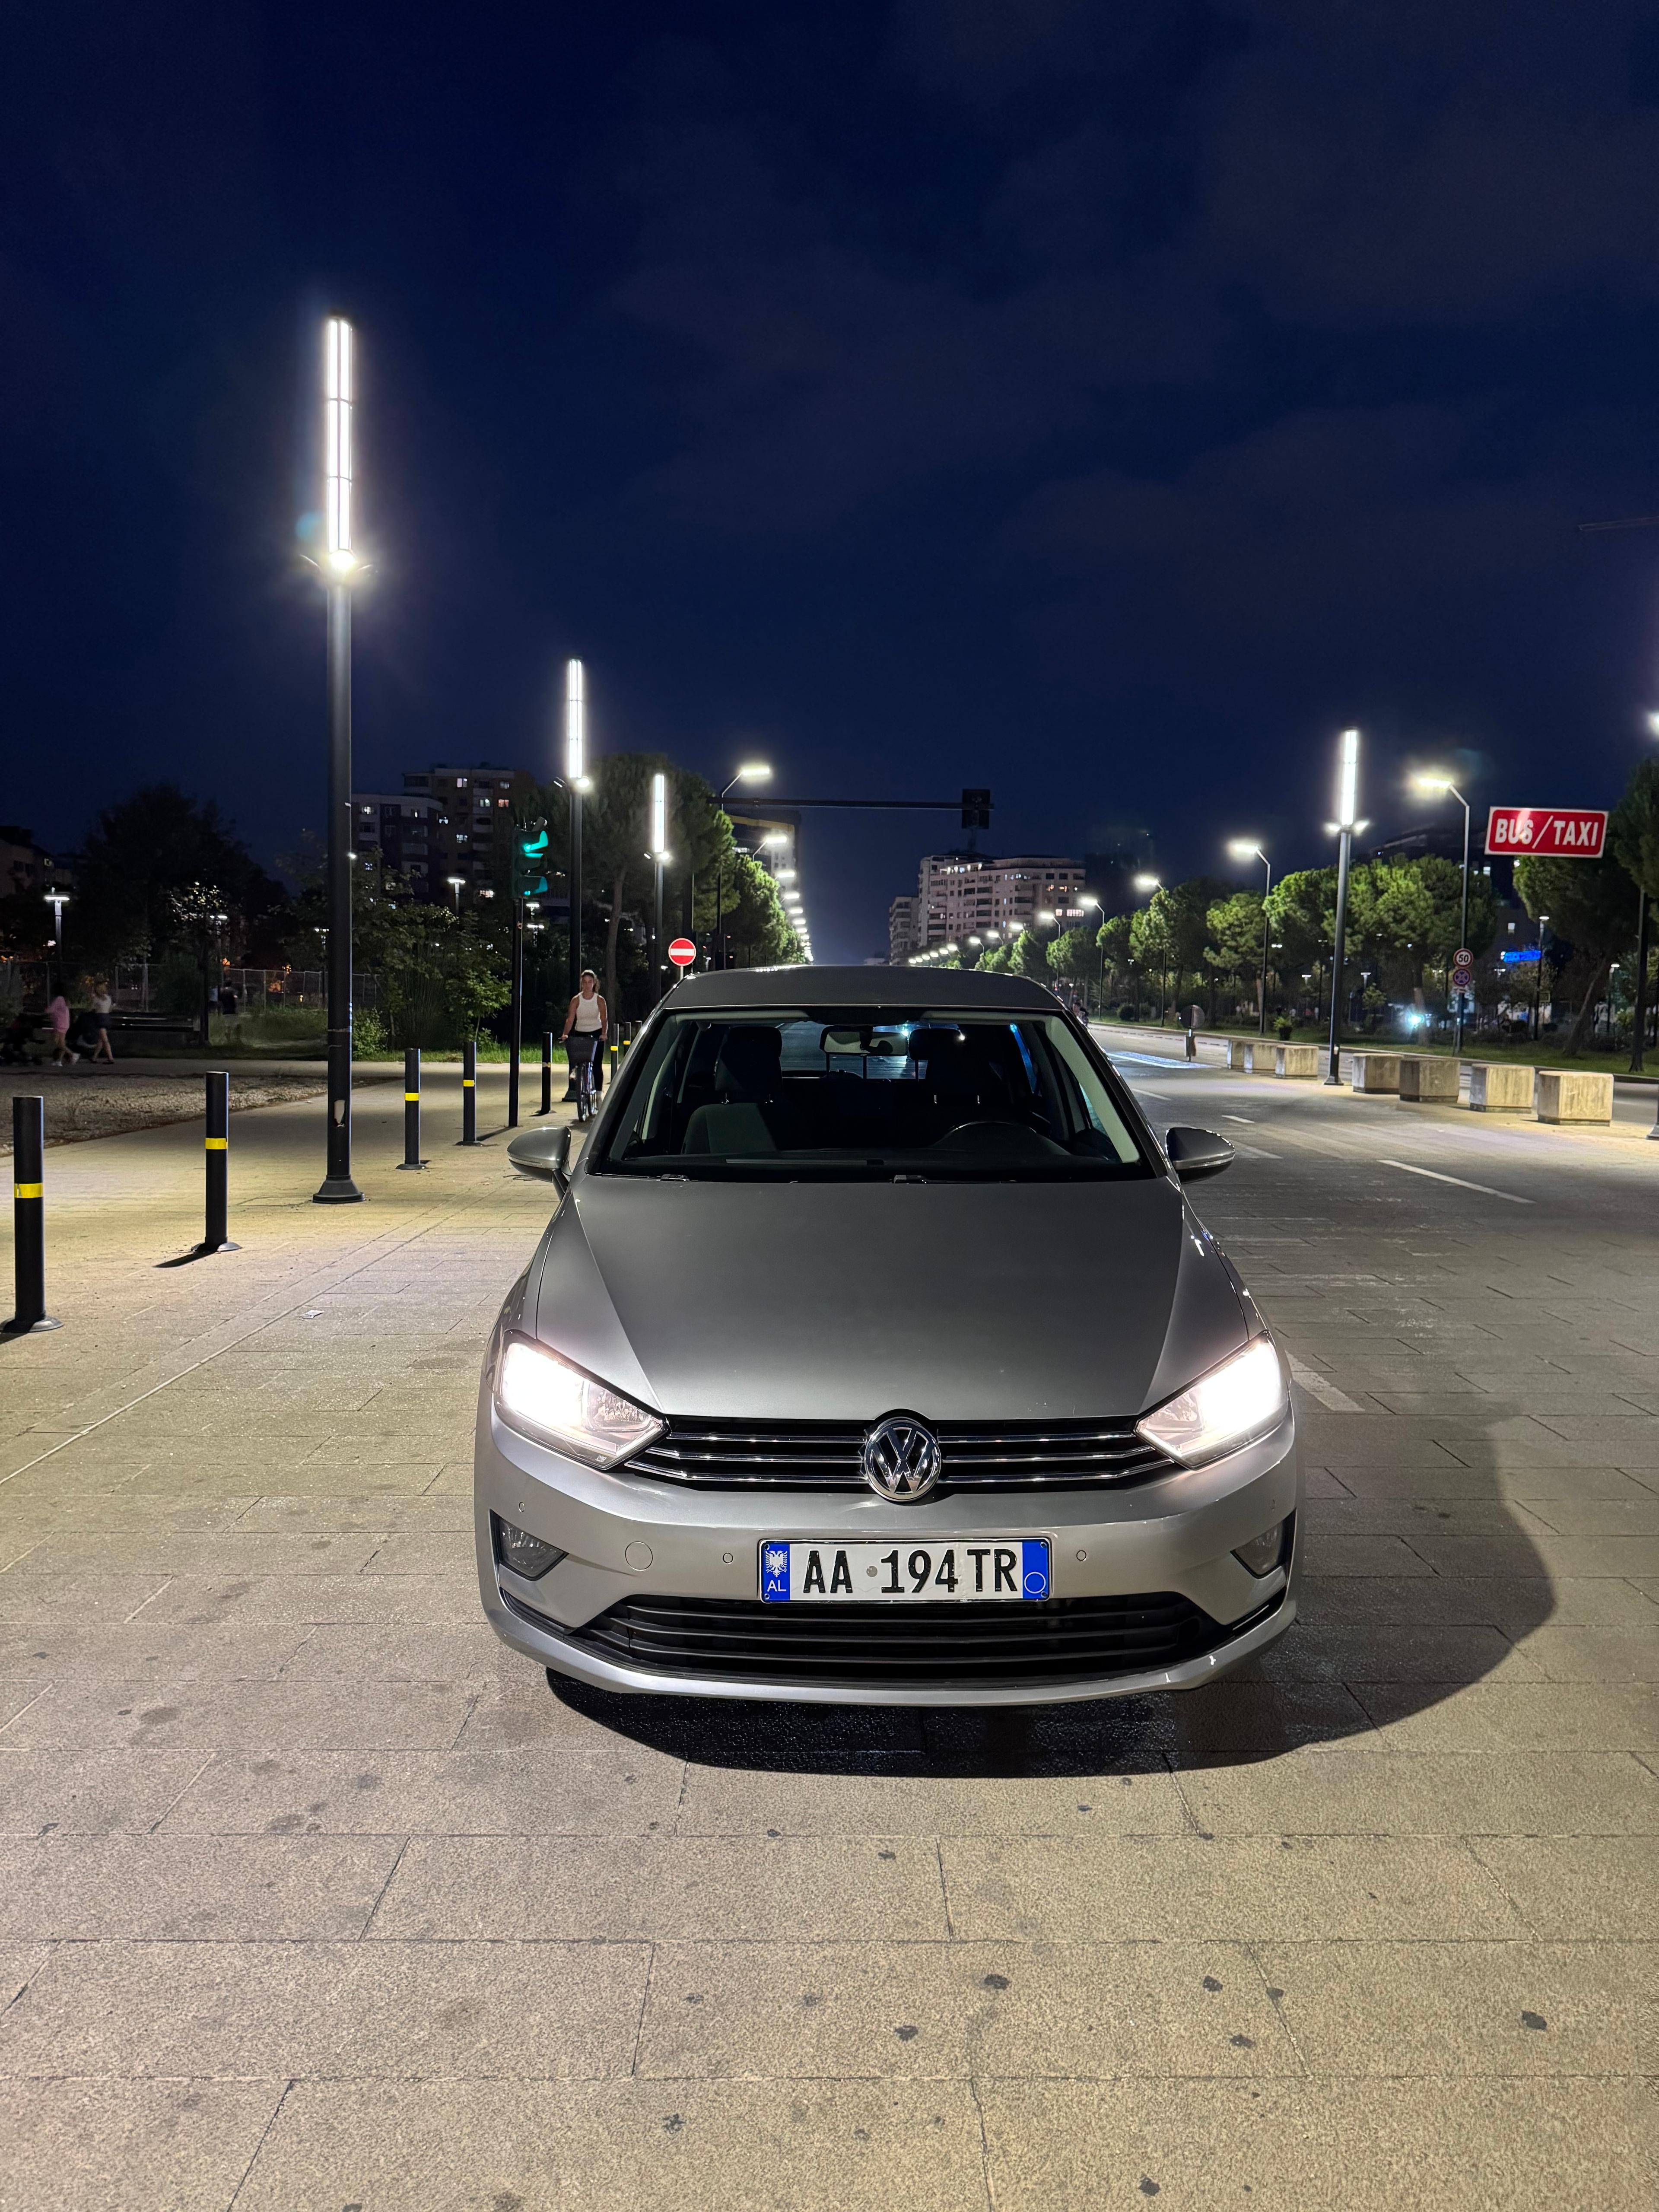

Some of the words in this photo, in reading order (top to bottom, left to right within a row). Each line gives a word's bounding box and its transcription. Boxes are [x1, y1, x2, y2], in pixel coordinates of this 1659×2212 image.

[1459, 954, 1469, 963] 50
[803, 1550, 853, 1594] AA
[767, 1580, 787, 1592] AL
